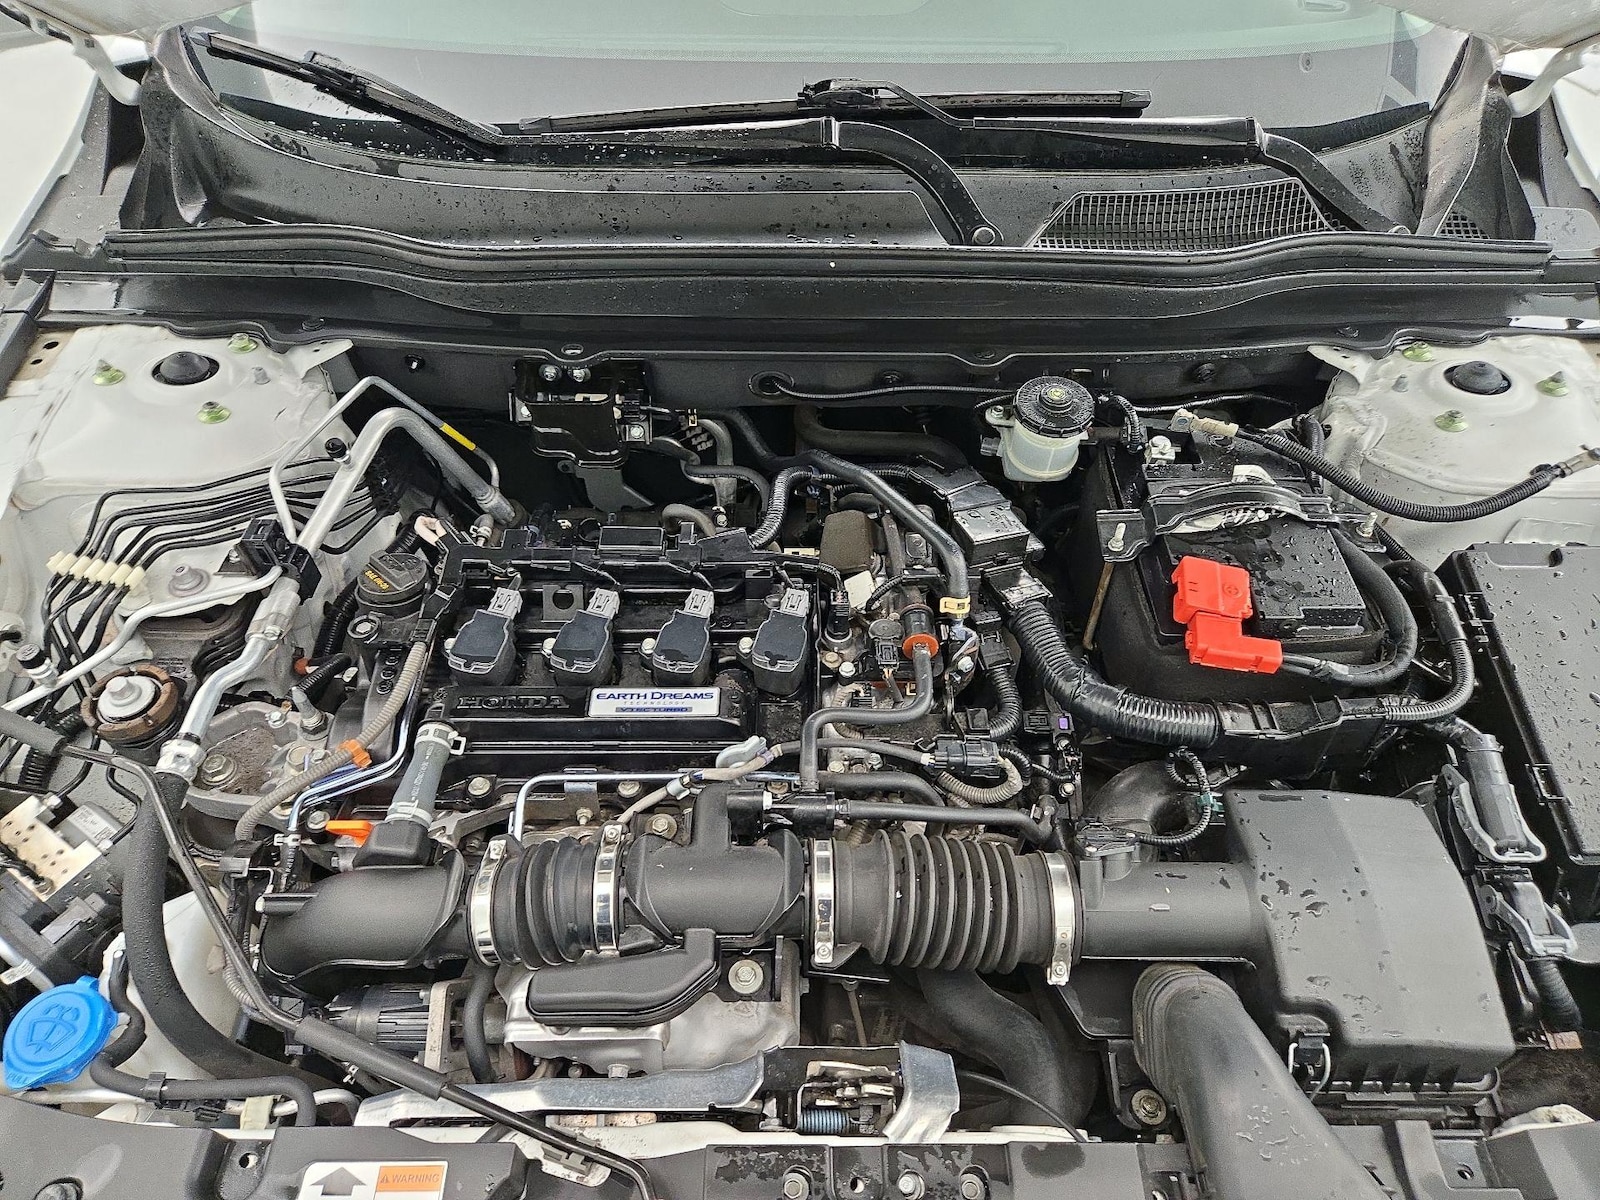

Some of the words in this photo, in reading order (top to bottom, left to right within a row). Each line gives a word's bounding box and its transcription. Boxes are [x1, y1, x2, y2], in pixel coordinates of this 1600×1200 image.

[596, 692, 647, 700] EARTH
[651, 691, 714, 700] DREAMS
[457, 696, 570, 709] HONDA
[392, 1173, 440, 1184] WARNING
